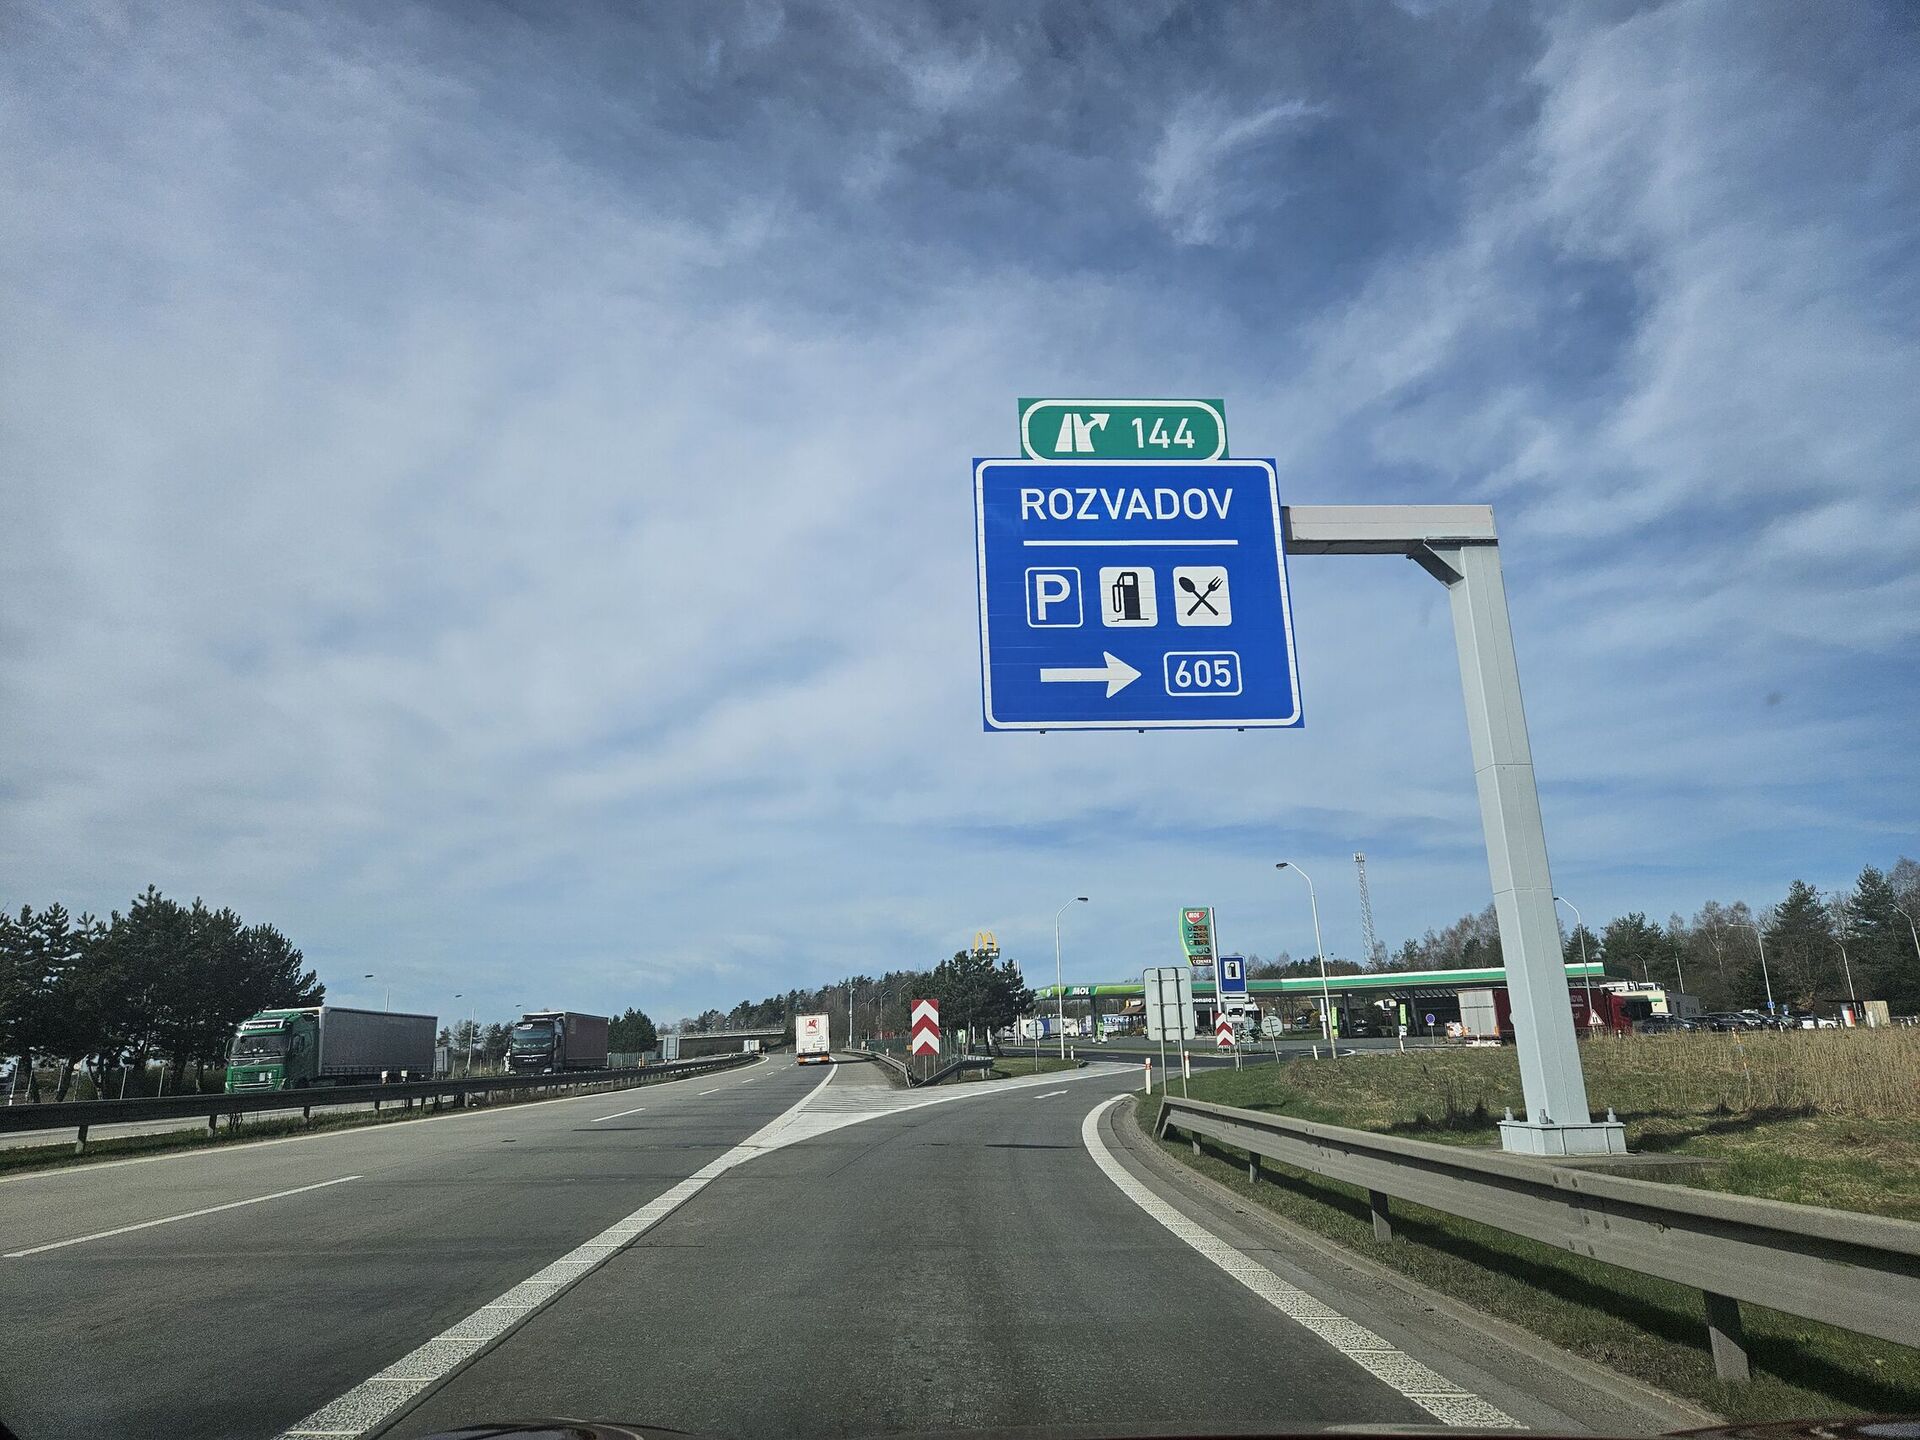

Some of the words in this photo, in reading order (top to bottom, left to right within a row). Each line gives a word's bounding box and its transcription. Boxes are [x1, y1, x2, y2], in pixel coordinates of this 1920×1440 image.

[1131, 417, 1195, 449] 144
[1020, 487, 1233, 520] ROZVADOV
[1035, 573, 1071, 621] P
[1174, 659, 1232, 688] 605
[1072, 986, 1090, 995] MOL
